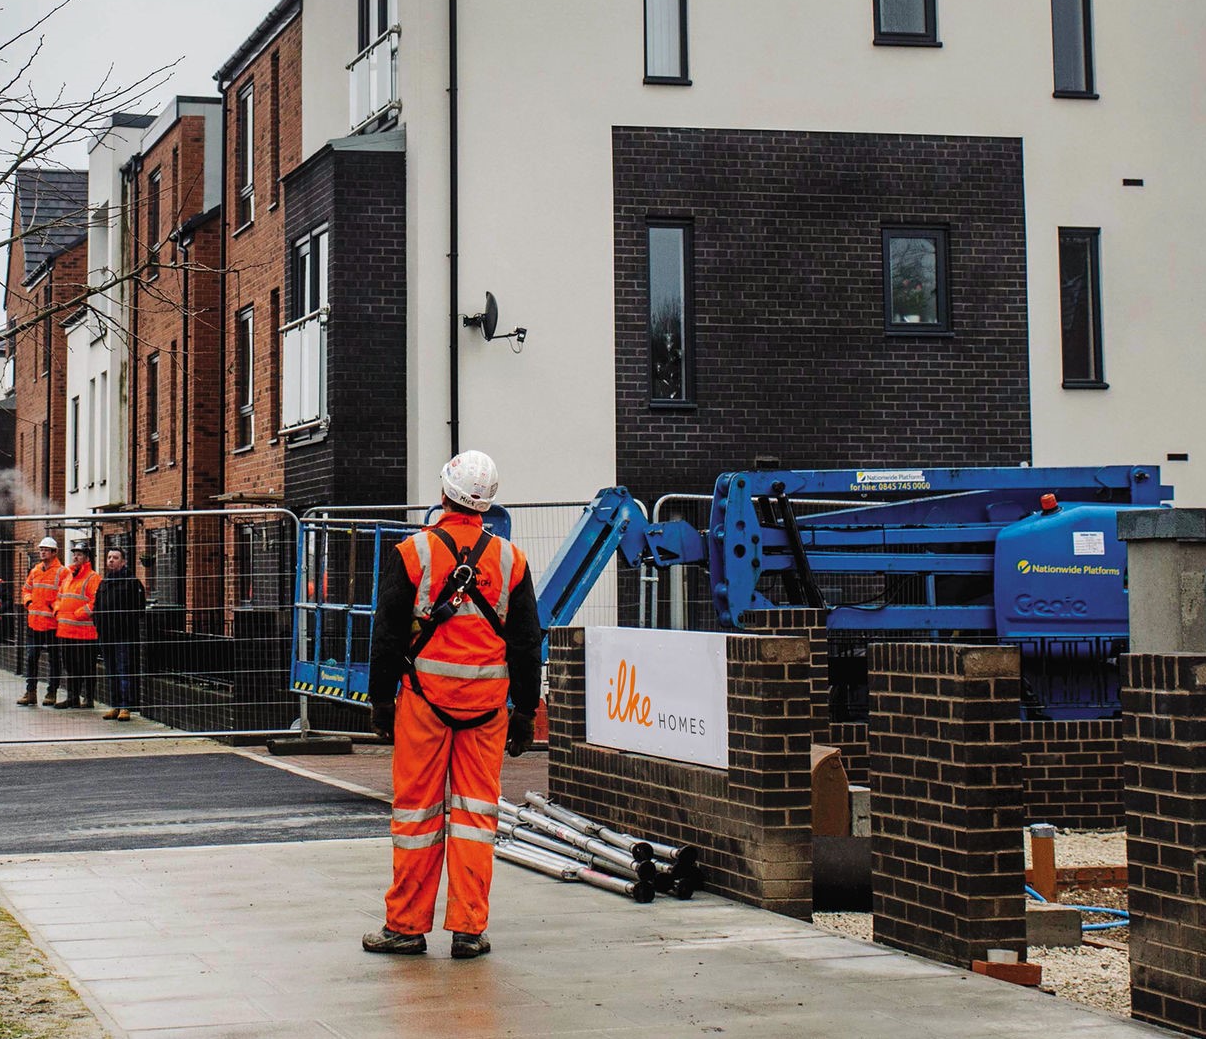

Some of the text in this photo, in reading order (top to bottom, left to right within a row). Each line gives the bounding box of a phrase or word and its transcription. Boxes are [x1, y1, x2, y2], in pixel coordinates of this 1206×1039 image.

[850, 483, 861, 491] for
[878, 482, 897, 490] 0845
[898, 482, 912, 490] 745
[1032, 564, 1120, 576] Nationwide Platforms
[1015, 593, 1087, 617] Genie
[606, 658, 706, 736] ilke HOMES
